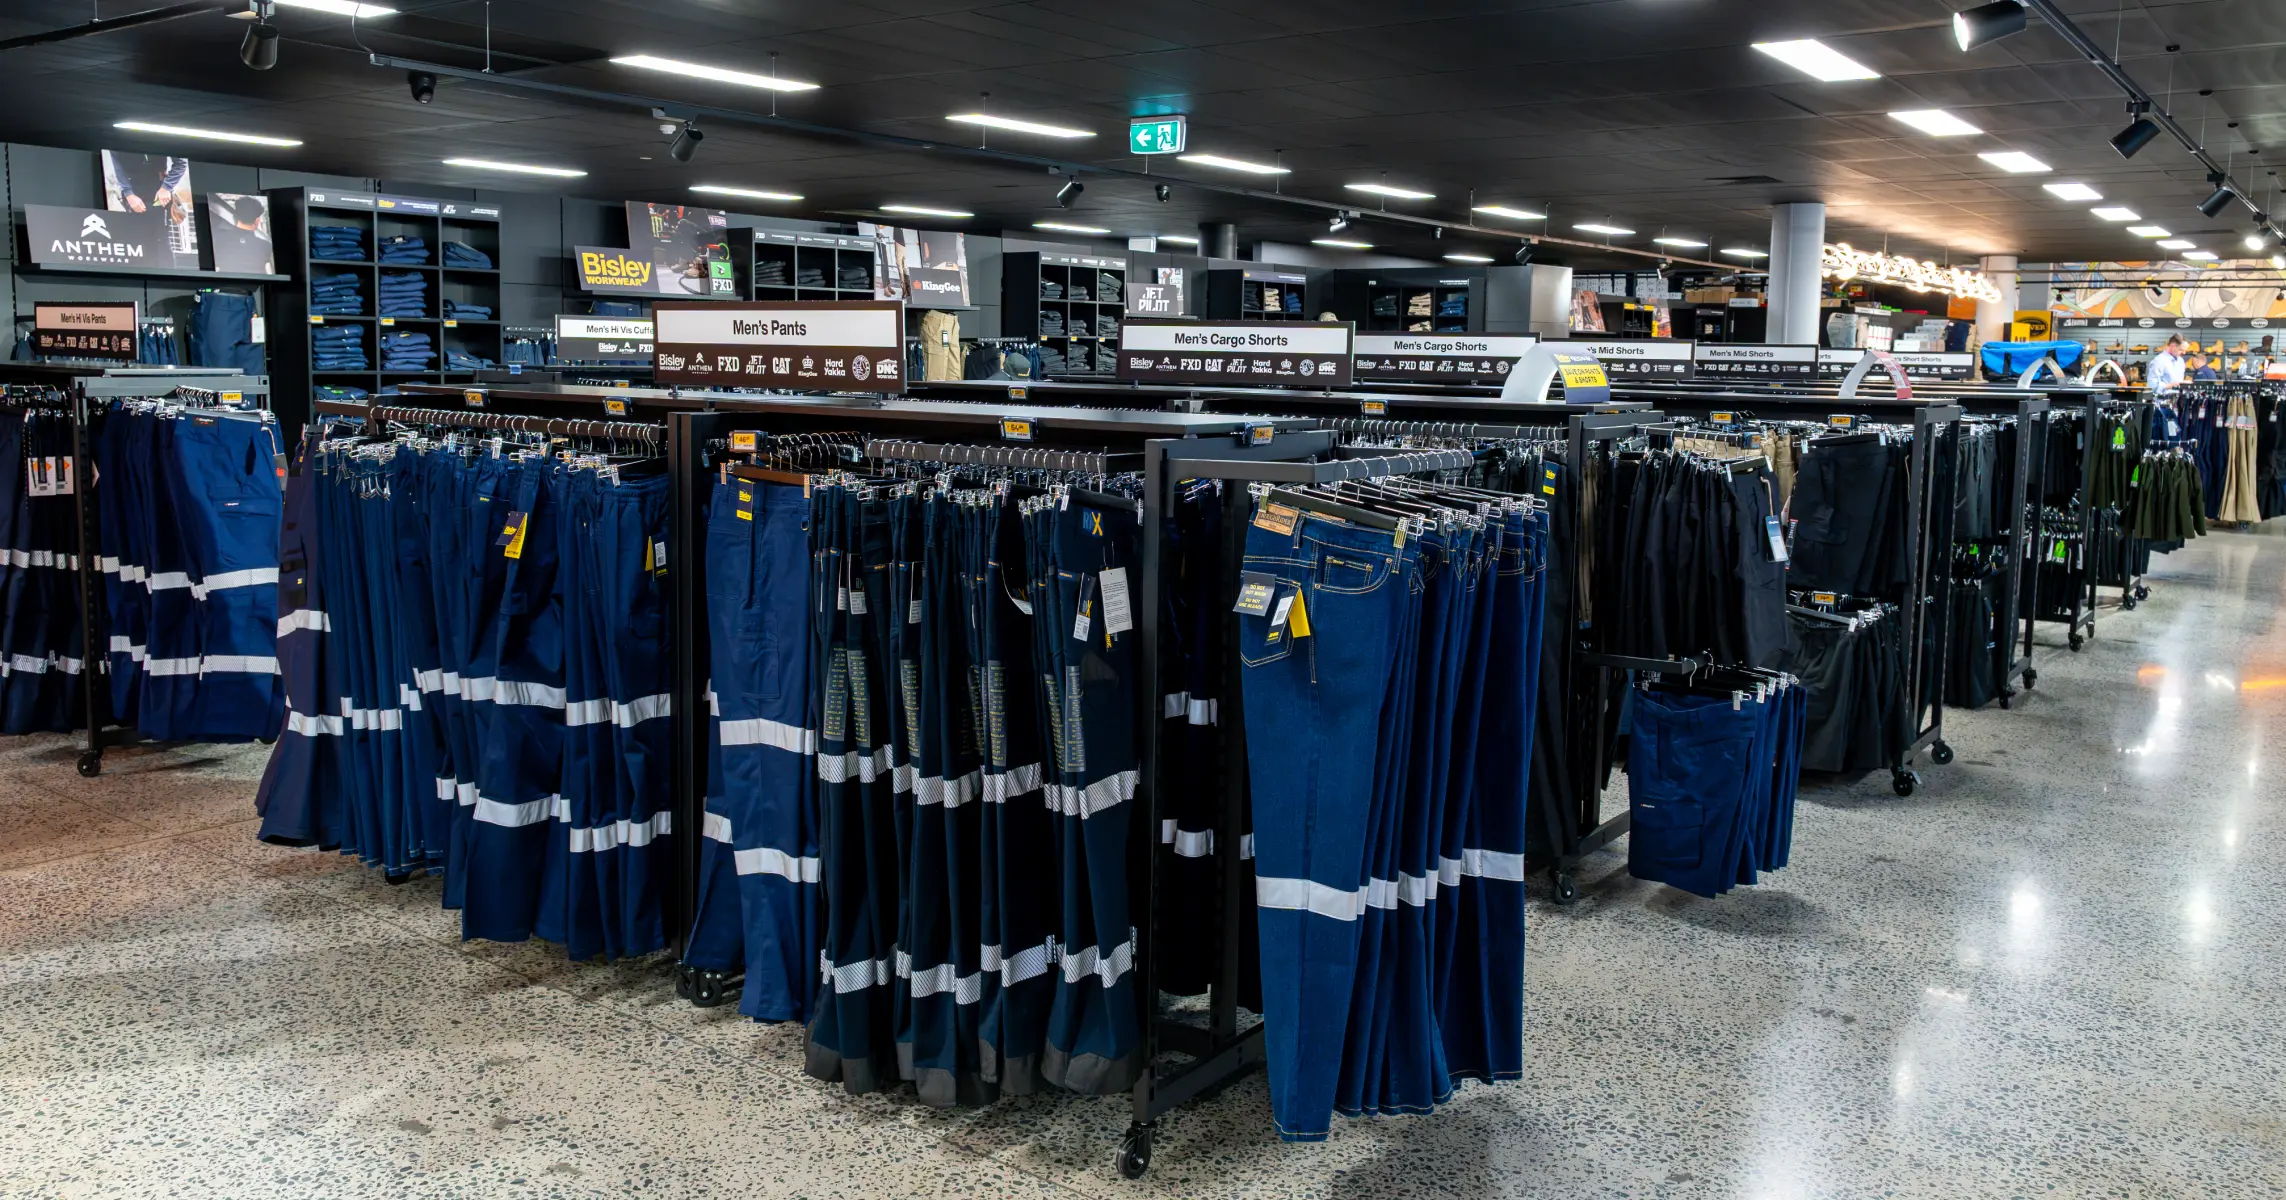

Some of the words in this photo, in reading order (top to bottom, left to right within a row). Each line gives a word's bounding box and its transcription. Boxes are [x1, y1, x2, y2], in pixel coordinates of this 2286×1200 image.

[51, 239, 144, 257] ANTHEM
[67, 255, 129, 263] WORKWEAR
[581, 252, 651, 283] Bisley
[585, 275, 642, 287] WORKWEAR
[711, 278, 733, 291] FXD
[921, 280, 961, 293] KingGee
[1142, 287, 1164, 299] JET
[1138, 299, 1170, 312] PILOT
[61, 313, 75, 323] Men's
[76, 313, 81, 323] Hi
[82, 313, 91, 324] Vis
[91, 314, 107, 324] Pants
[586, 325, 609, 334] Men's
[611, 325, 618, 333] Hi
[620, 326, 632, 334] Vis
[633, 326, 654, 334] Cuffe
[733, 320, 768, 335] Men's
[771, 320, 807, 336] Pants
[1174, 333, 1207, 345] Men's
[1210, 333, 1245, 348] Cargo
[1248, 333, 1288, 346] Shorts
[638, 343, 653, 353] FXD
[1394, 341, 1421, 350] Men's
[1423, 341, 1453, 352] Cargo
[1455, 341, 1487, 351] Shorts
[1616, 347, 1644, 355] Shorts
[659, 353, 685, 369] Bisley
[717, 356, 740, 372] FXD
[748, 355, 763, 365] JET
[772, 357, 791, 374] CAT
[825, 358, 843, 368] Hard
[1130, 357, 1154, 368] Bisley
[1180, 358, 1201, 371] FXD
[1204, 358, 1223, 372] CAT
[1253, 359, 1271, 367] Hard
[1398, 360, 1417, 370] FXD
[688, 364, 713, 372] ANTHEM
[745, 364, 766, 374] PILOT
[824, 367, 846, 376] Yakka
[876, 364, 898, 374] DNC
[1251, 366, 1273, 374] Yakka
[1419, 360, 1434, 372] CAT
